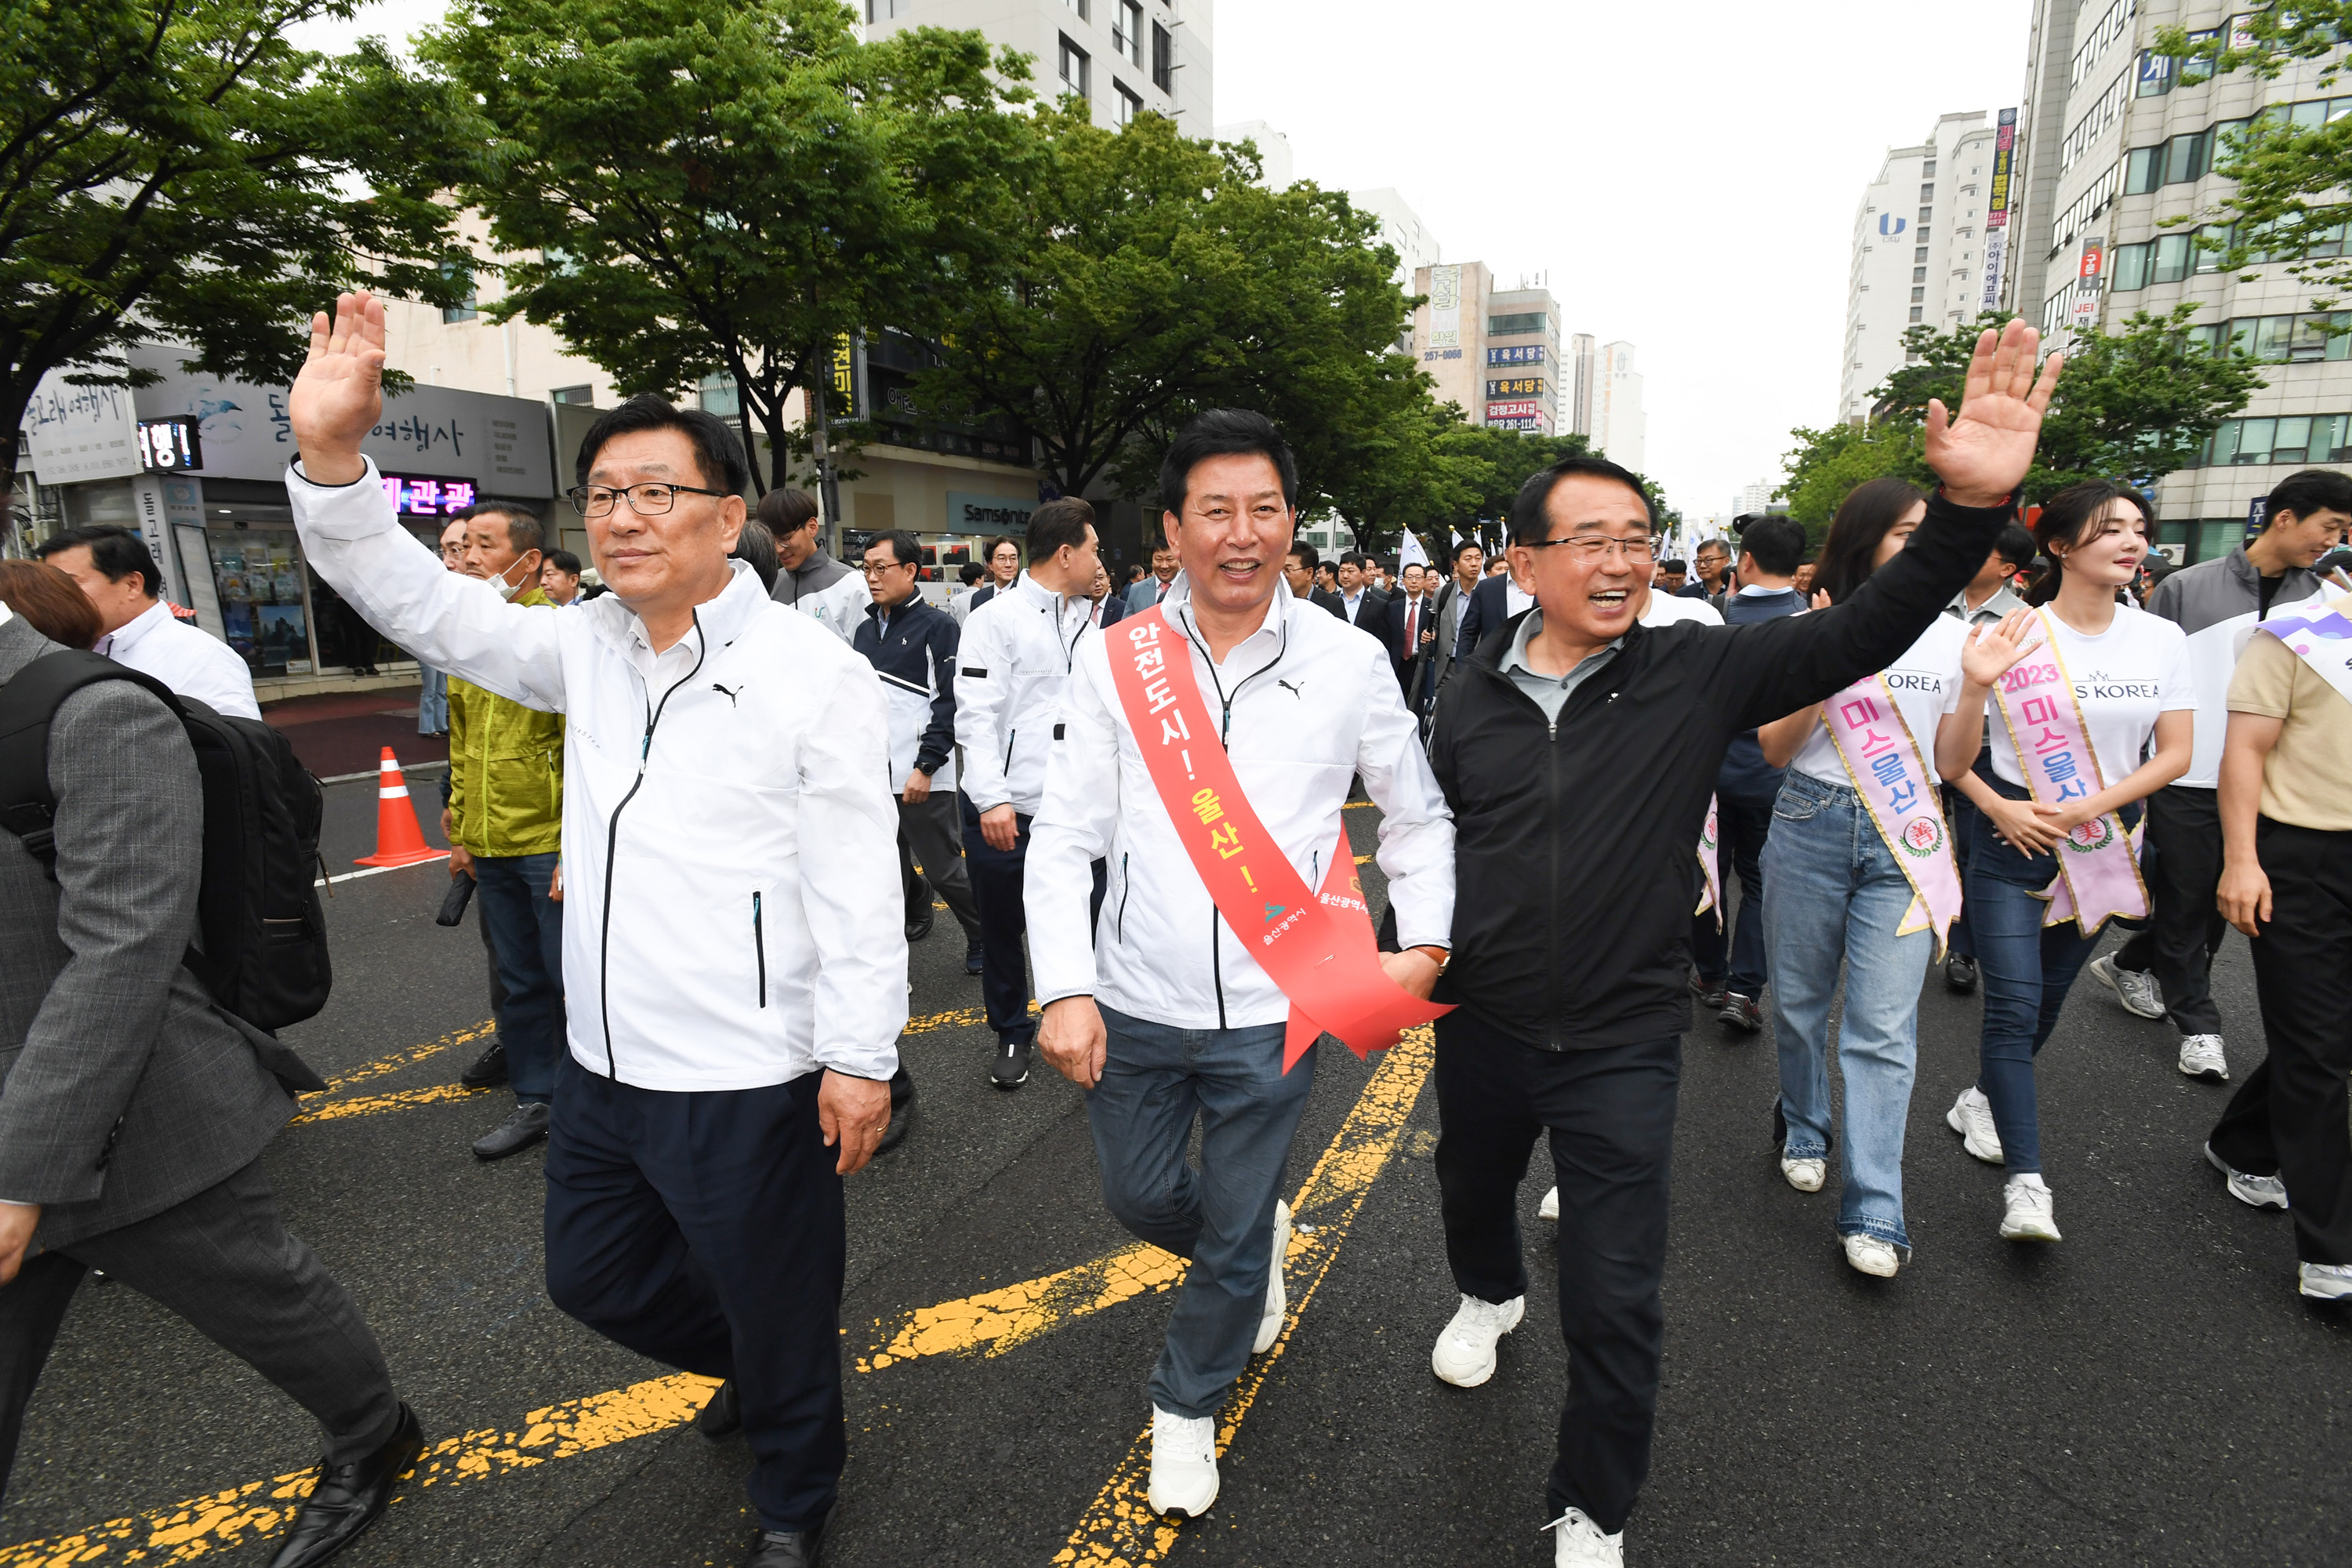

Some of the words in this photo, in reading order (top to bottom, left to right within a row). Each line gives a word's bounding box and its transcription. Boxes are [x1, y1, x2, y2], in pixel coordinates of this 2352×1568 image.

[2074, 303, 2095, 314] JEI
[1431, 330, 1457, 346] 학원
[1489, 403, 1527, 416] 검정고시
[1505, 418, 1536, 430] 261-1114
[2000, 663, 2060, 695] 2023
[1910, 822, 1935, 847] 善
[1320, 892, 1370, 915] 울산광역시
[1262, 907, 1307, 946] 울산광역시
